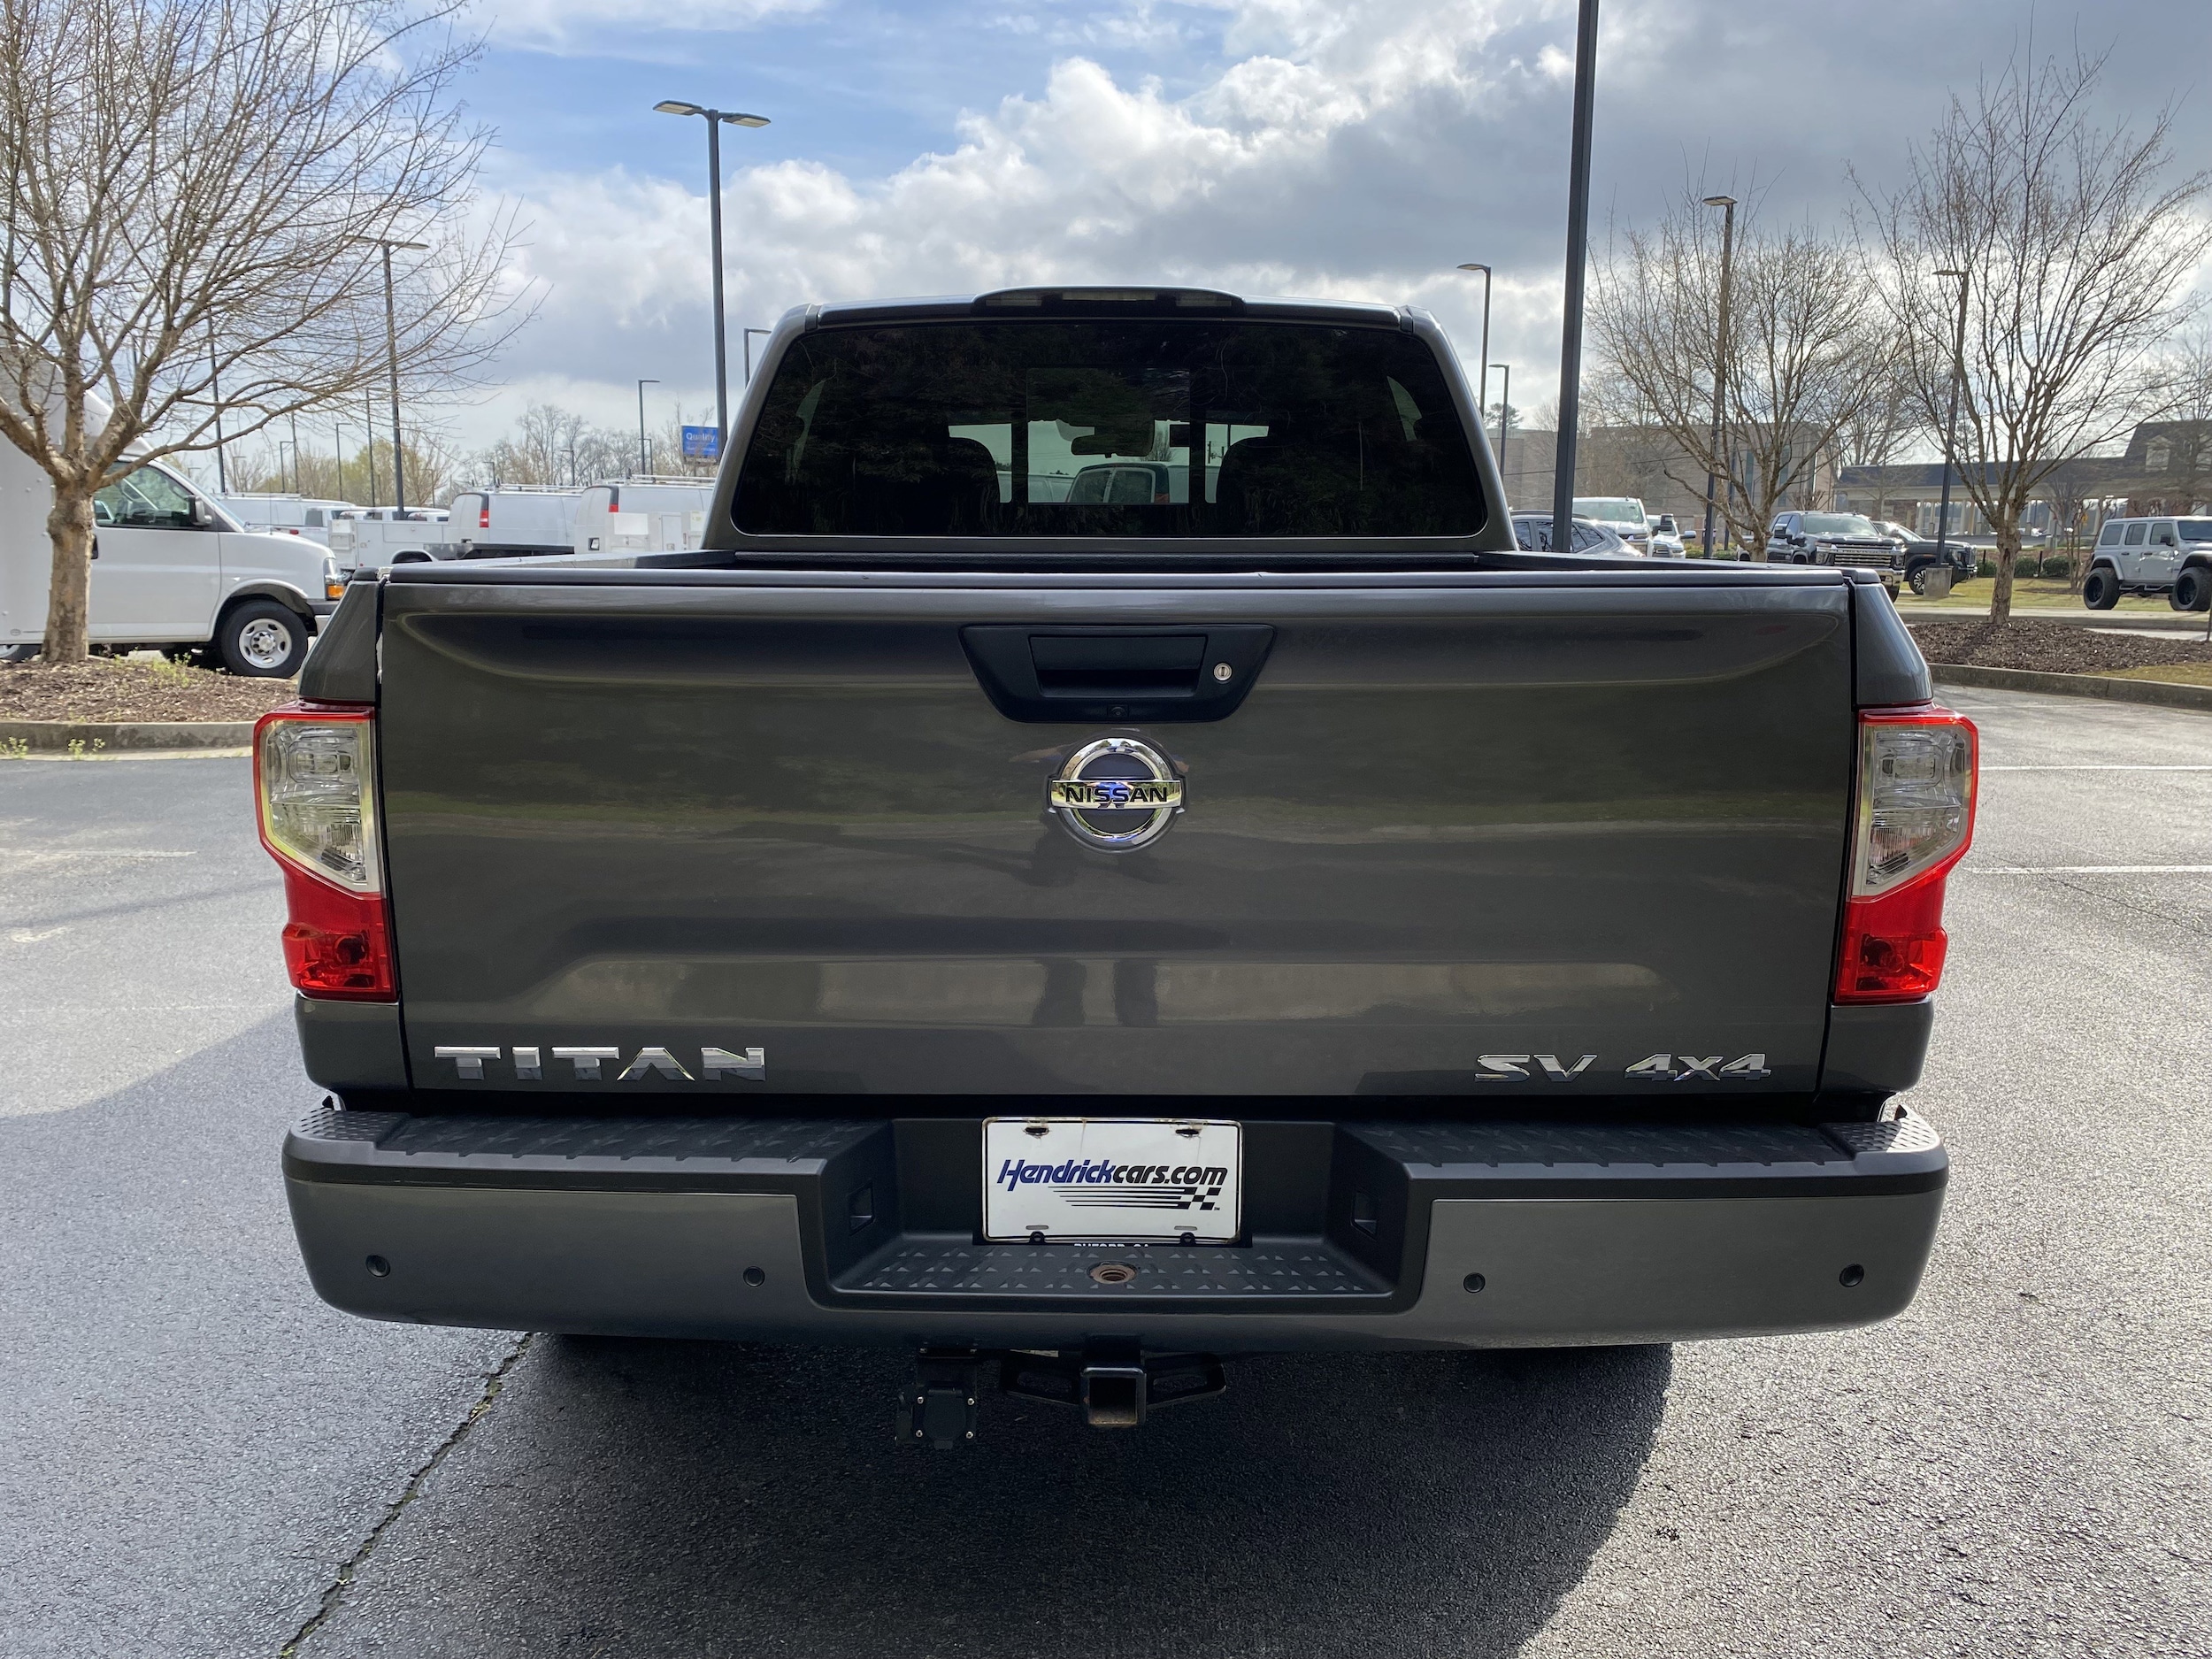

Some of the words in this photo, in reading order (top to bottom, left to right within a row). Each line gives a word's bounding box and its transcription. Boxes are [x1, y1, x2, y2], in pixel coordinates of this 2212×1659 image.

[686, 432, 715, 443] Quality
[1065, 787, 1167, 803] NISSAN
[434, 1046, 765, 1081] TITAN
[1474, 1053, 1598, 1082] SV
[996, 1159, 1229, 1192] Hendrickcars.com
